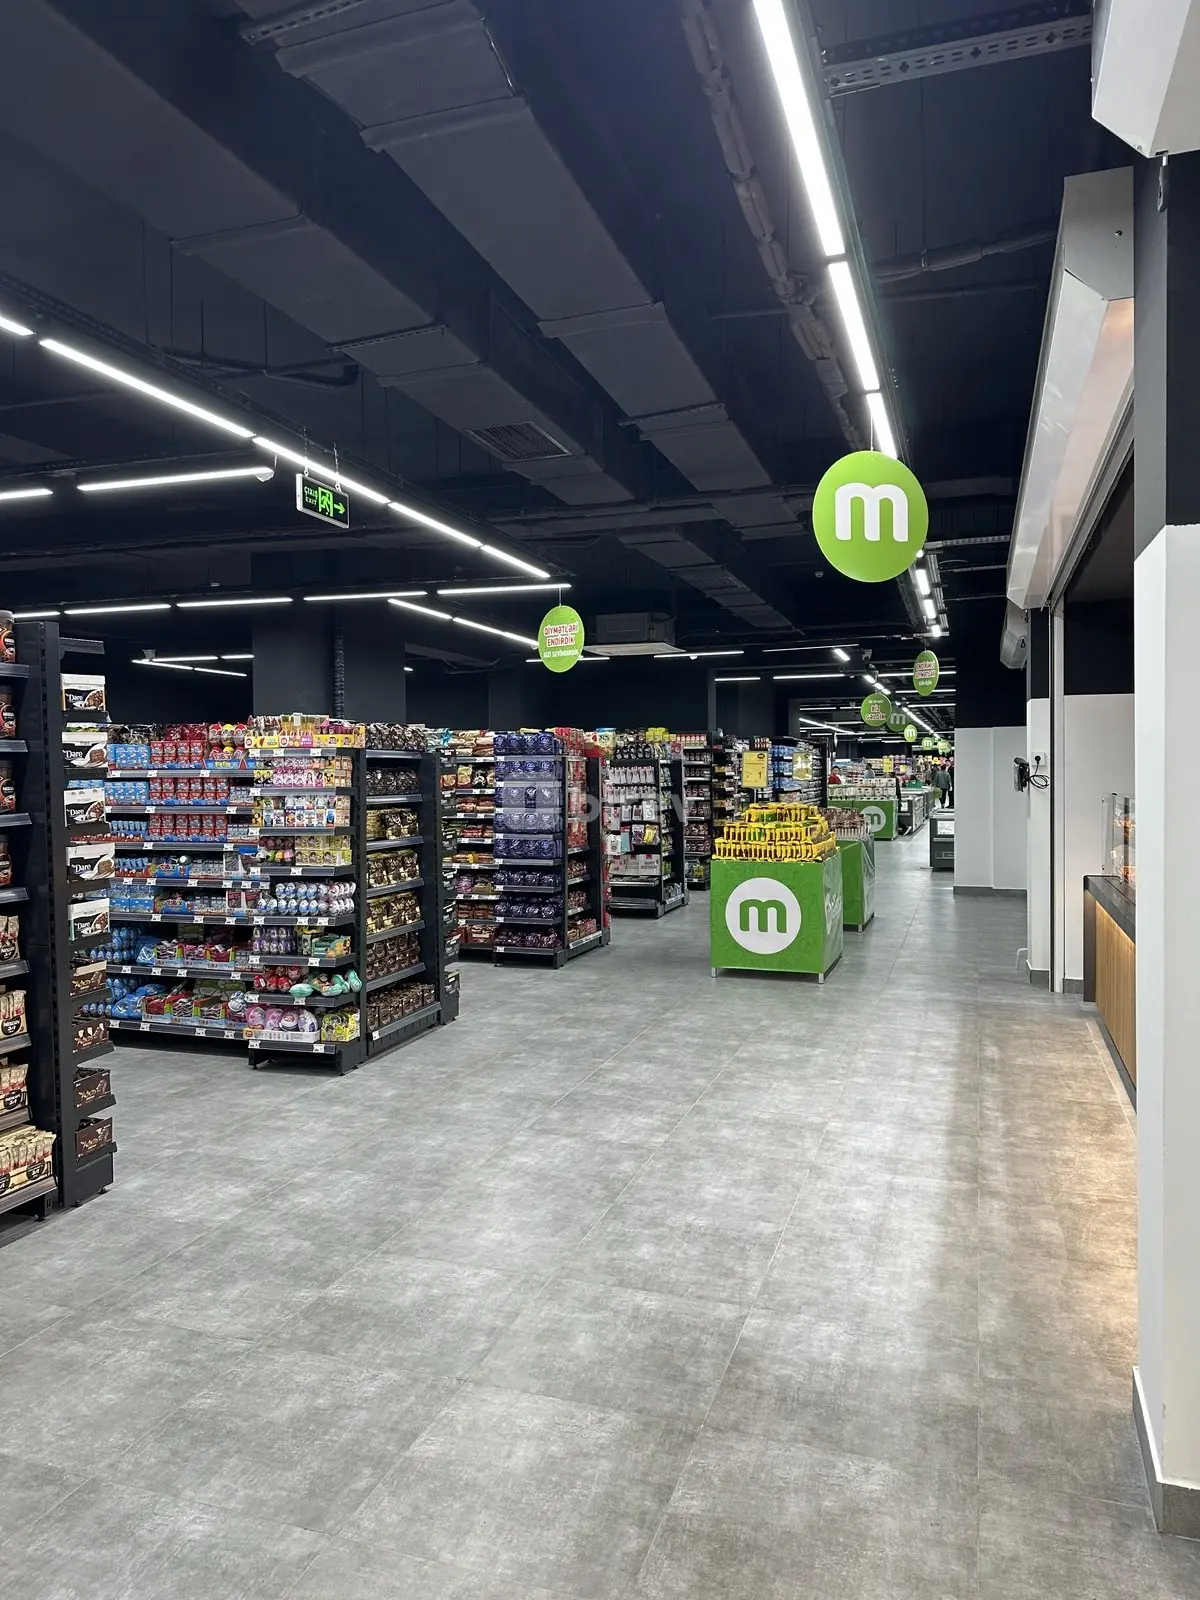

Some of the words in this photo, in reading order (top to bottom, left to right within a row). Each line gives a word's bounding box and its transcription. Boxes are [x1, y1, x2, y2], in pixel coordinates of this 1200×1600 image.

[306, 496, 317, 506] EXIT
[834, 482, 909, 542] m
[739, 898, 788, 933] m
